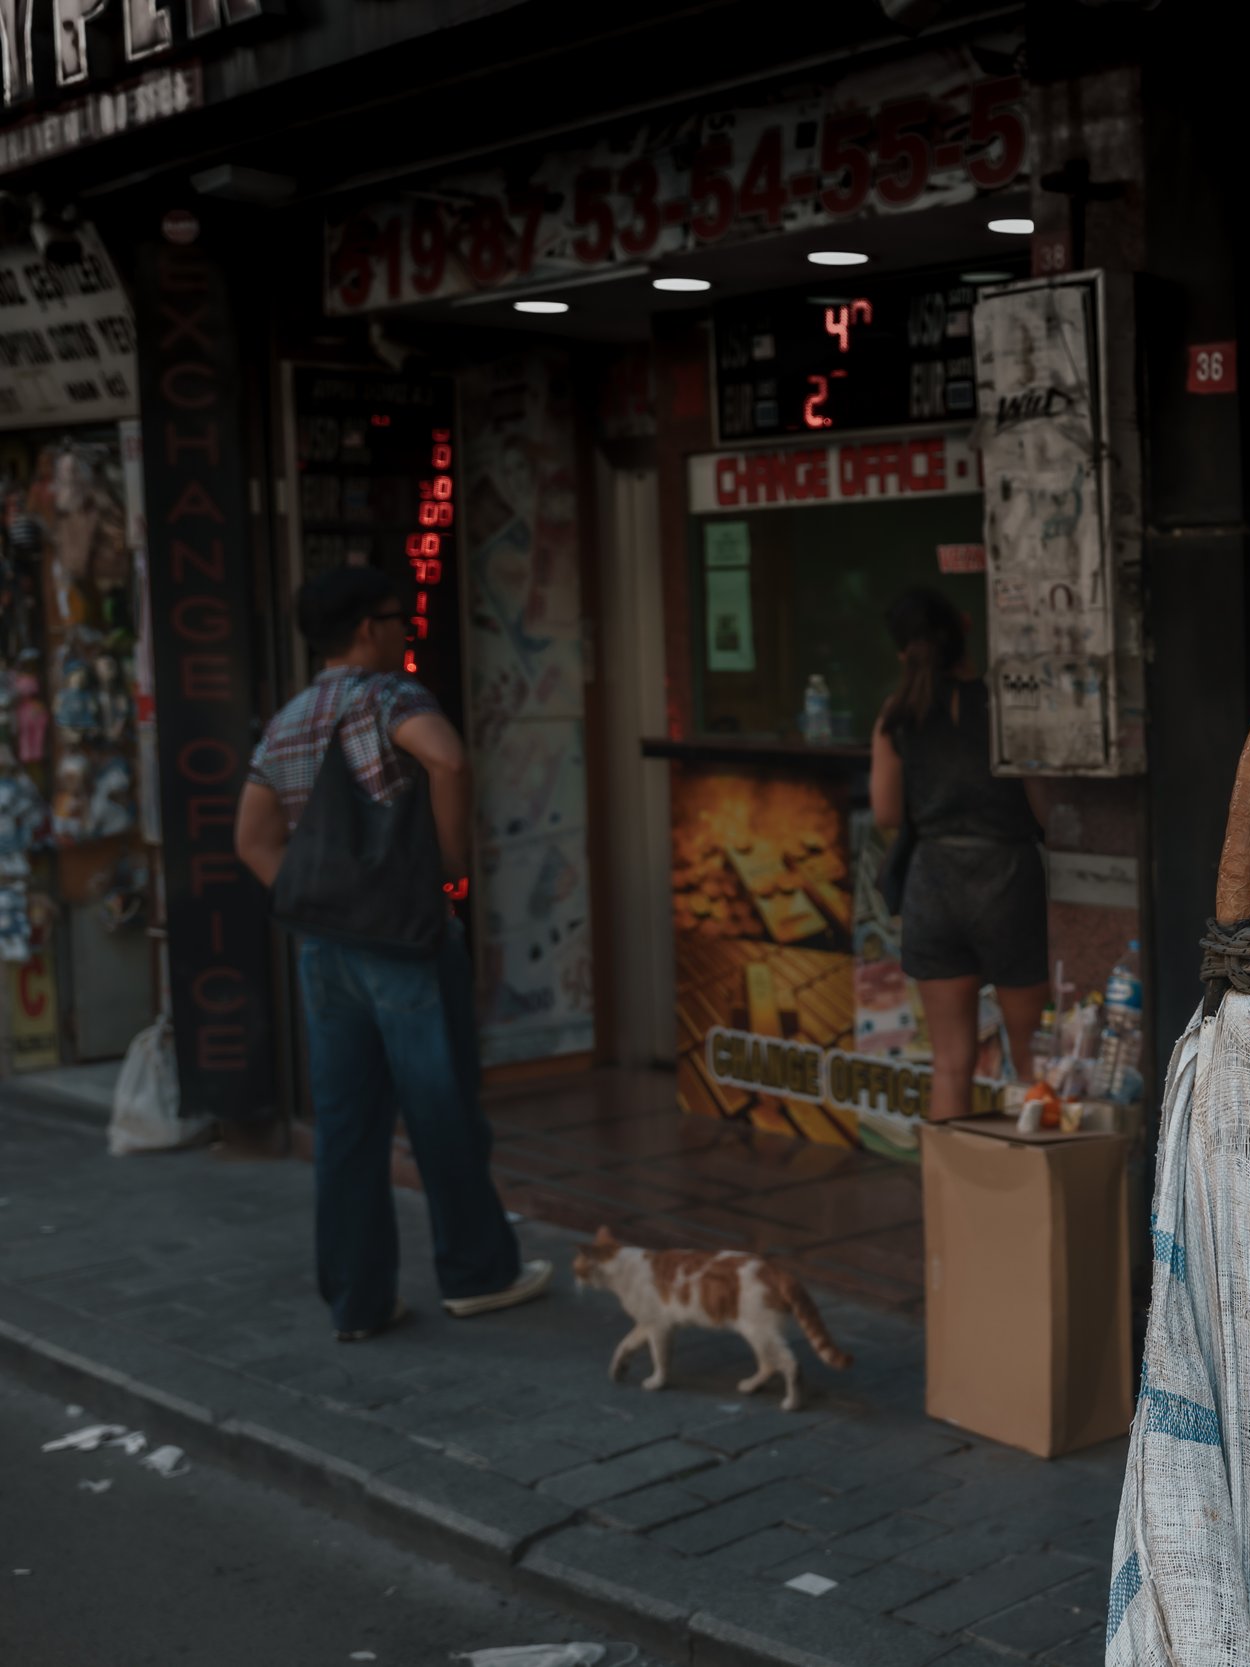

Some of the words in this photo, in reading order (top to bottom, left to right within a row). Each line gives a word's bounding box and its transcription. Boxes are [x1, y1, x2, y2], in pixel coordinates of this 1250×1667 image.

[1195, 352, 1225, 381] 36
[159, 244, 233, 702] EXCHANGE
[716, 447, 830, 507] CHANGE
[839, 436, 946, 497] OFFICE
[175, 736, 248, 1072] OFFICE
[711, 1032, 821, 1097] CHANGE
